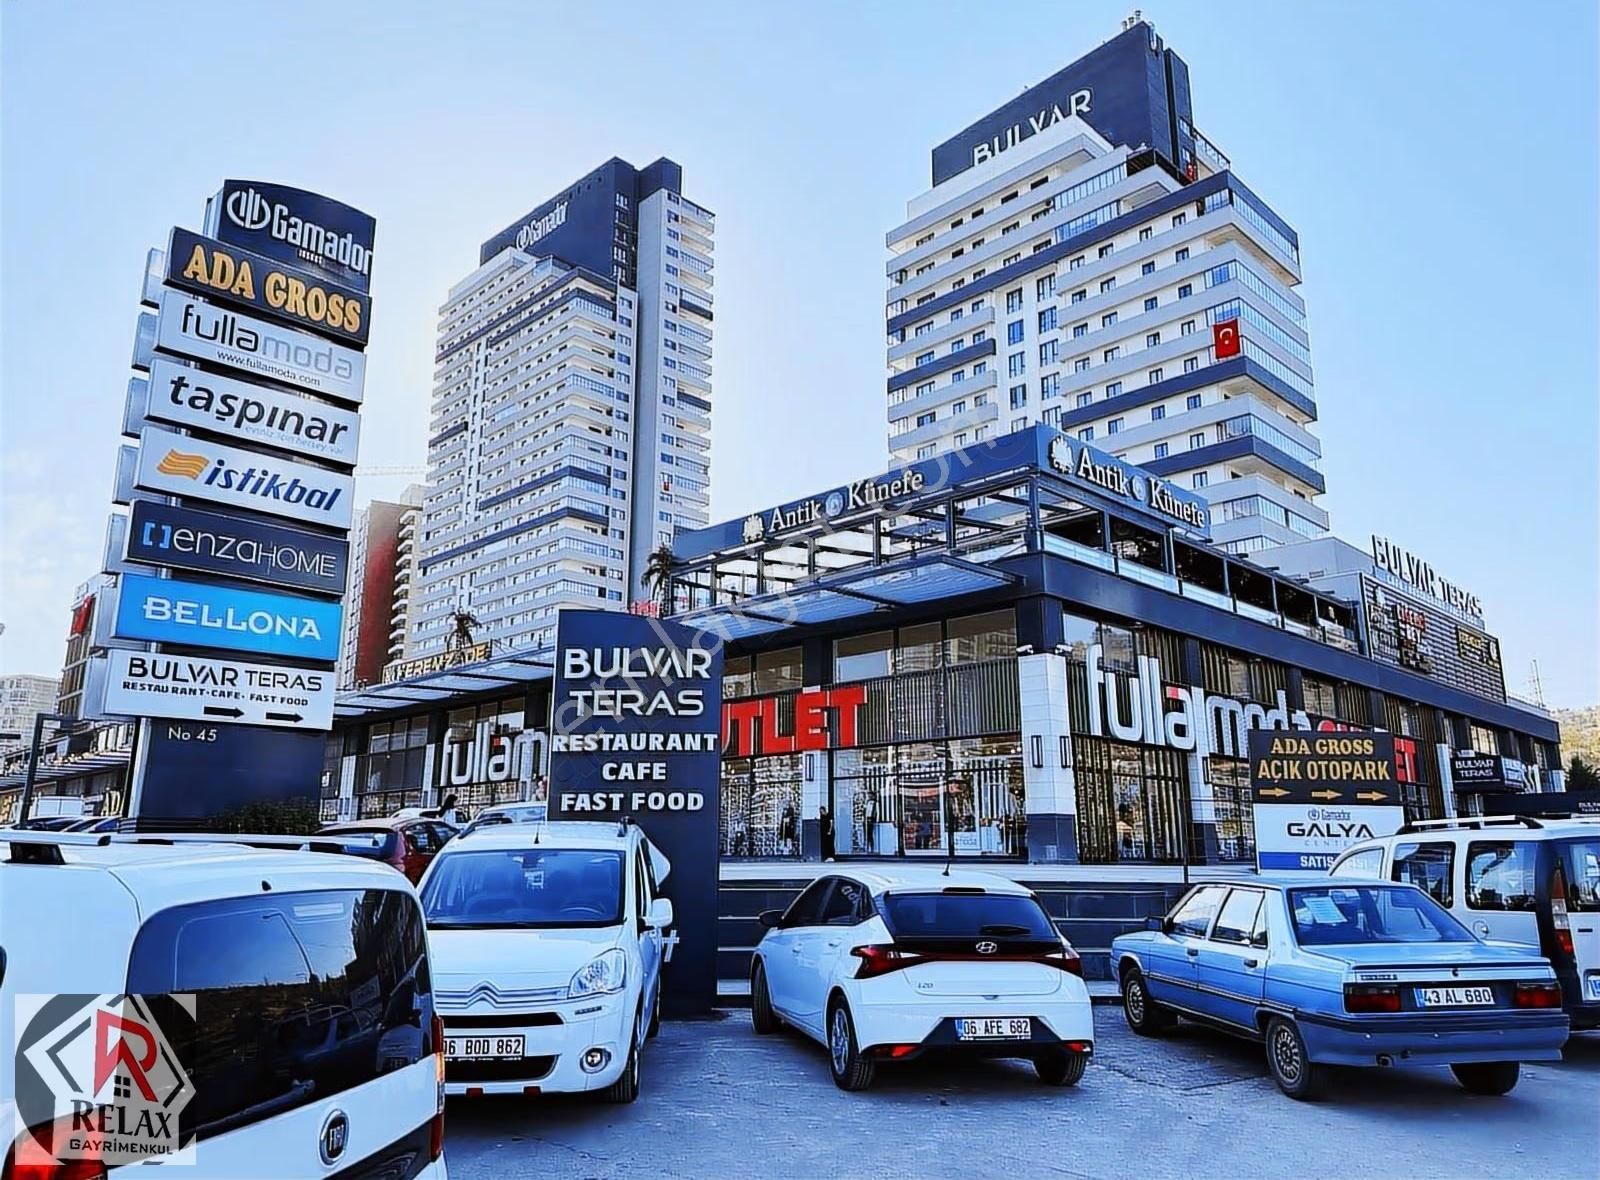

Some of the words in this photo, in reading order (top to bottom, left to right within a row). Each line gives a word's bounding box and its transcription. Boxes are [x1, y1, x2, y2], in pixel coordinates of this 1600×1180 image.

[973, 89, 1092, 166] BULVAR
[272, 204, 372, 275] Gamador
[184, 244, 255, 300] ADA
[265, 272, 361, 333] GROSS
[182, 304, 352, 380] fullamoda
[217, 351, 321, 386] www.fullamoda.com
[169, 376, 348, 444] taşpınar
[205, 459, 342, 511] istikbal
[1077, 447, 1131, 498] Antik
[1149, 477, 1205, 528] Künefe
[768, 500, 821, 534] Antik
[847, 471, 923, 509] Künefe
[172, 527, 337, 577] enzaHOME
[1438, 576, 1483, 616] TERAS
[142, 596, 321, 641] BELLONA
[128, 656, 239, 687] BULVAR
[245, 669, 323, 692] TERAS
[564, 647, 711, 680] BULVAR
[250, 693, 277, 704] FAST
[280, 696, 308, 706] FOOD
[569, 690, 703, 716] TERAS
[168, 726, 191, 741] No
[197, 728, 217, 742] 45
[552, 733, 717, 752] RESTAURANT
[1271, 738, 1311, 755] ADA
[1315, 738, 1374, 755] GROSS
[602, 762, 666, 780] CAFE
[1258, 760, 1301, 783] AÇIK
[1306, 760, 1391, 781] OTOPARK
[1455, 760, 1495, 769] BULVAR
[1460, 769, 1494, 778] TERAS
[560, 793, 624, 811] FAST
[631, 792, 704, 811] FOOD
[1287, 822, 1375, 838] GALYA
[1424, 988, 1440, 1004] 43
[1446, 988, 1462, 1004] AL
[1465, 988, 1491, 1003] 680
[963, 1020, 976, 1035] 06
[984, 1020, 1002, 1034] AFE
[1009, 1019, 1029, 1034] 682
[465, 1039, 490, 1054] BOD
[497, 1039, 521, 1054] 862
